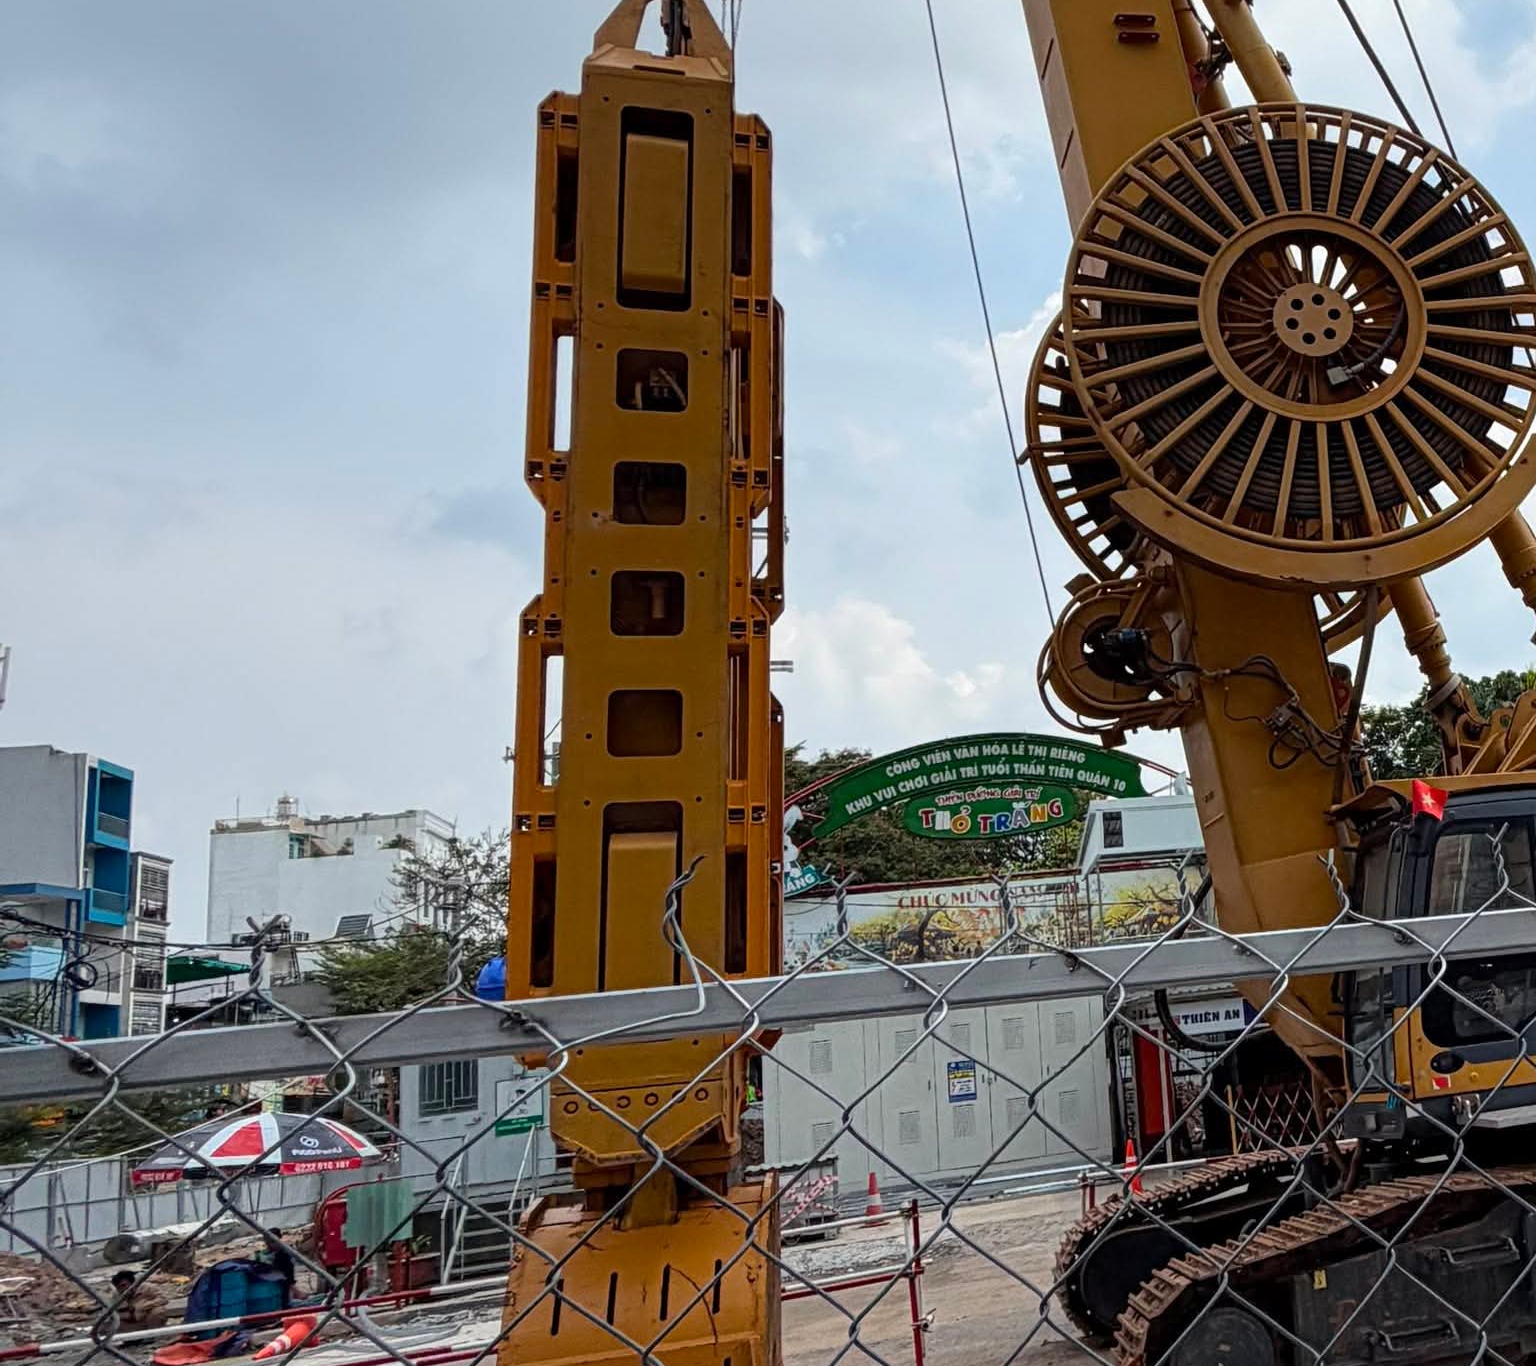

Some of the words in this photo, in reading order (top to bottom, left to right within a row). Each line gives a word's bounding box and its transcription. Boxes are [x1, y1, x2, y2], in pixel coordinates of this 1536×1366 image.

[885, 757, 921, 777] CÔNG
[922, 750, 952, 766] VIÊN
[845, 794, 873, 816] KHU
[873, 786, 897, 803] VUI
[897, 776, 929, 793] CHƠI
[930, 765, 958, 784] GIẢI
[959, 764, 978, 778] TRÍ
[1112, 778, 1127, 792] 10
[919, 805, 972, 835] THỎ
[977, 798, 1064, 834] TRẮNG
[1224, 1009, 1240, 1021] AN
